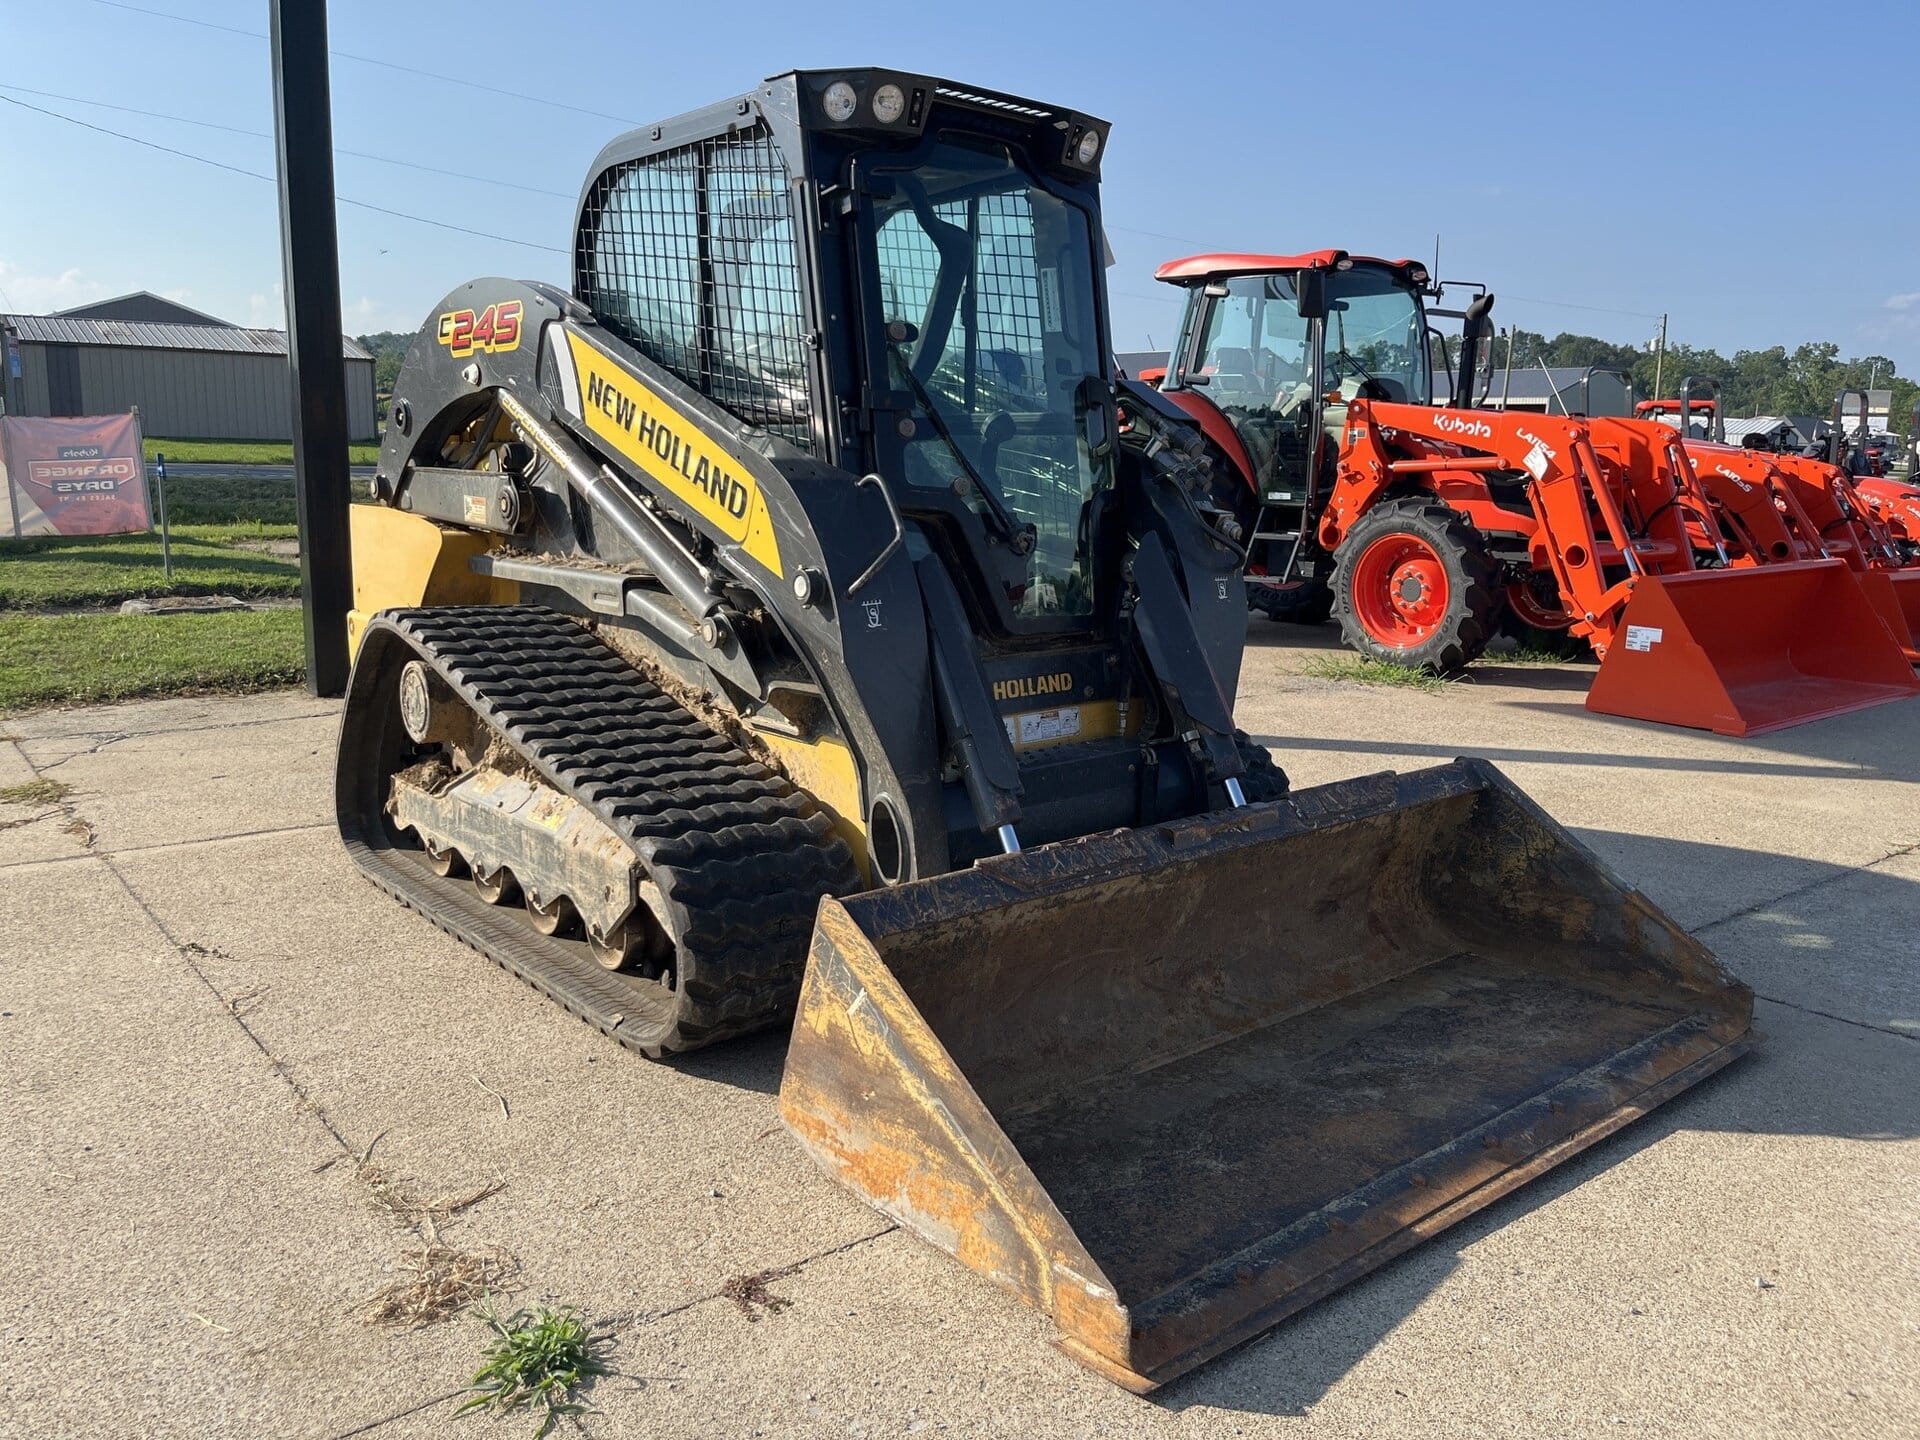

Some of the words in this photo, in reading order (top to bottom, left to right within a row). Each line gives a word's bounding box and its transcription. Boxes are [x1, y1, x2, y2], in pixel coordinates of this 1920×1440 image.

[438, 301, 523, 356] C245
[587, 370, 637, 433] NEW
[638, 410, 749, 520] HOLLAND
[1433, 413, 1492, 438] Kubota
[993, 672, 1073, 700] HOLLAND
